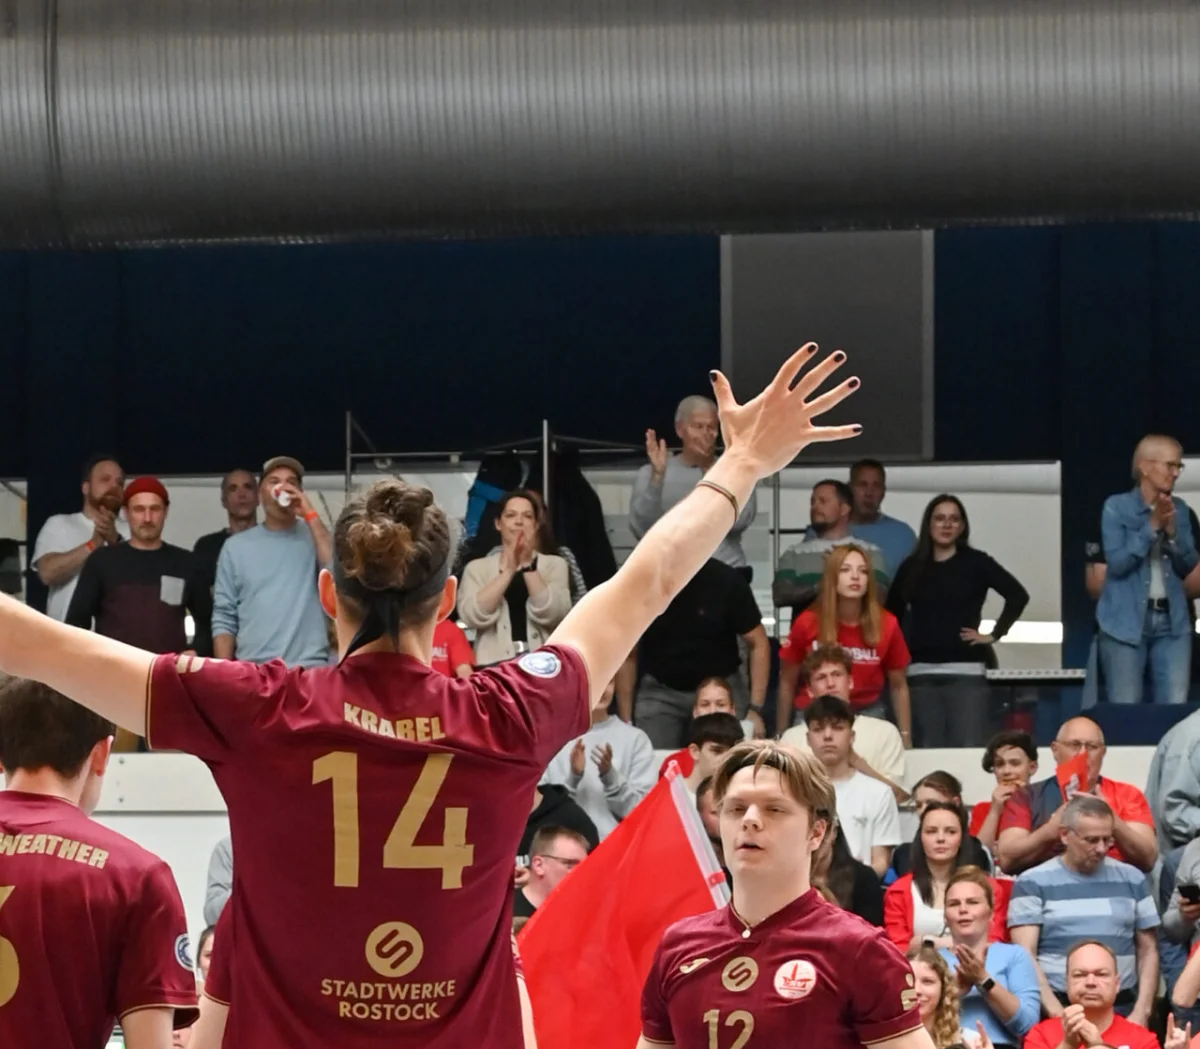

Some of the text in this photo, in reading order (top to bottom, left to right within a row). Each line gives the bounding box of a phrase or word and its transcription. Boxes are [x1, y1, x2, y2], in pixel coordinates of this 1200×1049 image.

[343, 702, 446, 742] KRABEL
[312, 751, 475, 890] 14
[321, 978, 456, 1001] STADTWERKE
[338, 1001, 441, 1021] ROSTOCK
